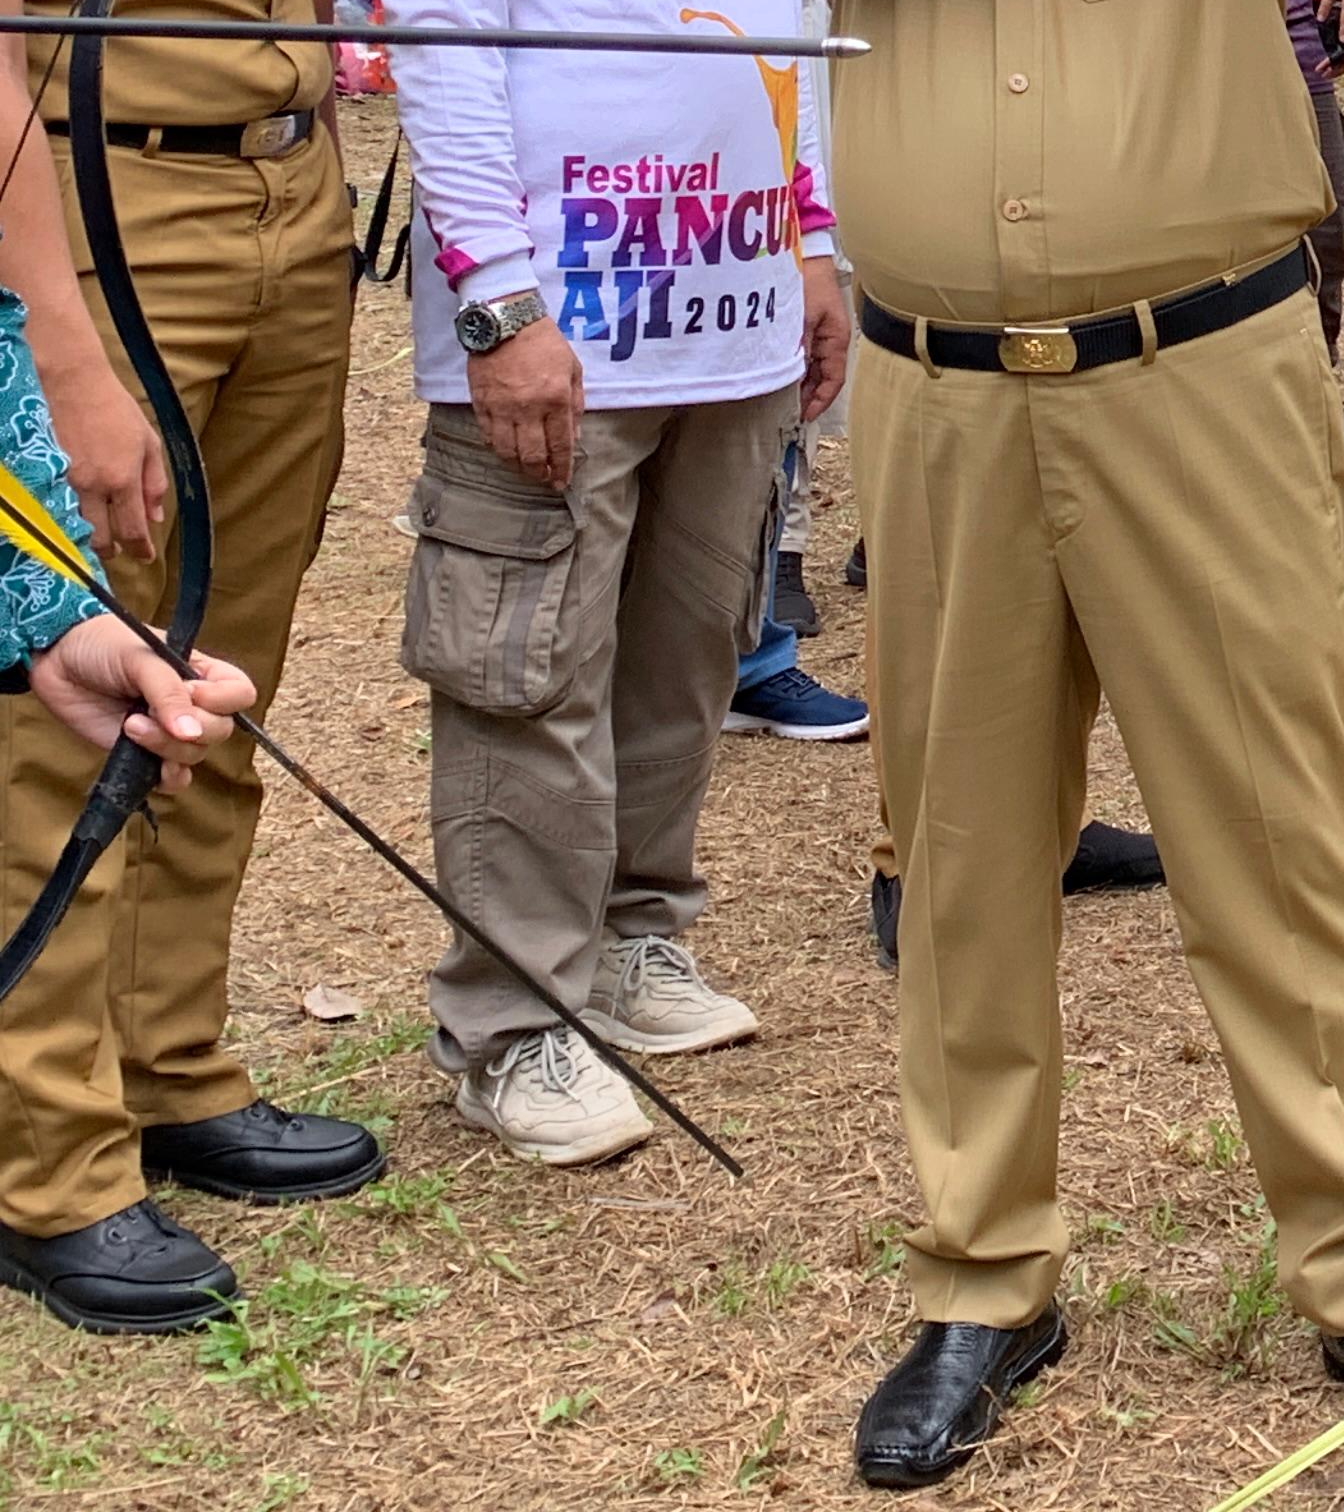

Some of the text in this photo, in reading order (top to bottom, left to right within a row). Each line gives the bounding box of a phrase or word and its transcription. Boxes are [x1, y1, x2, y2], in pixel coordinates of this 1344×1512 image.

[563, 152, 719, 194] Festival
[557, 270, 776, 362] AJI 2024
